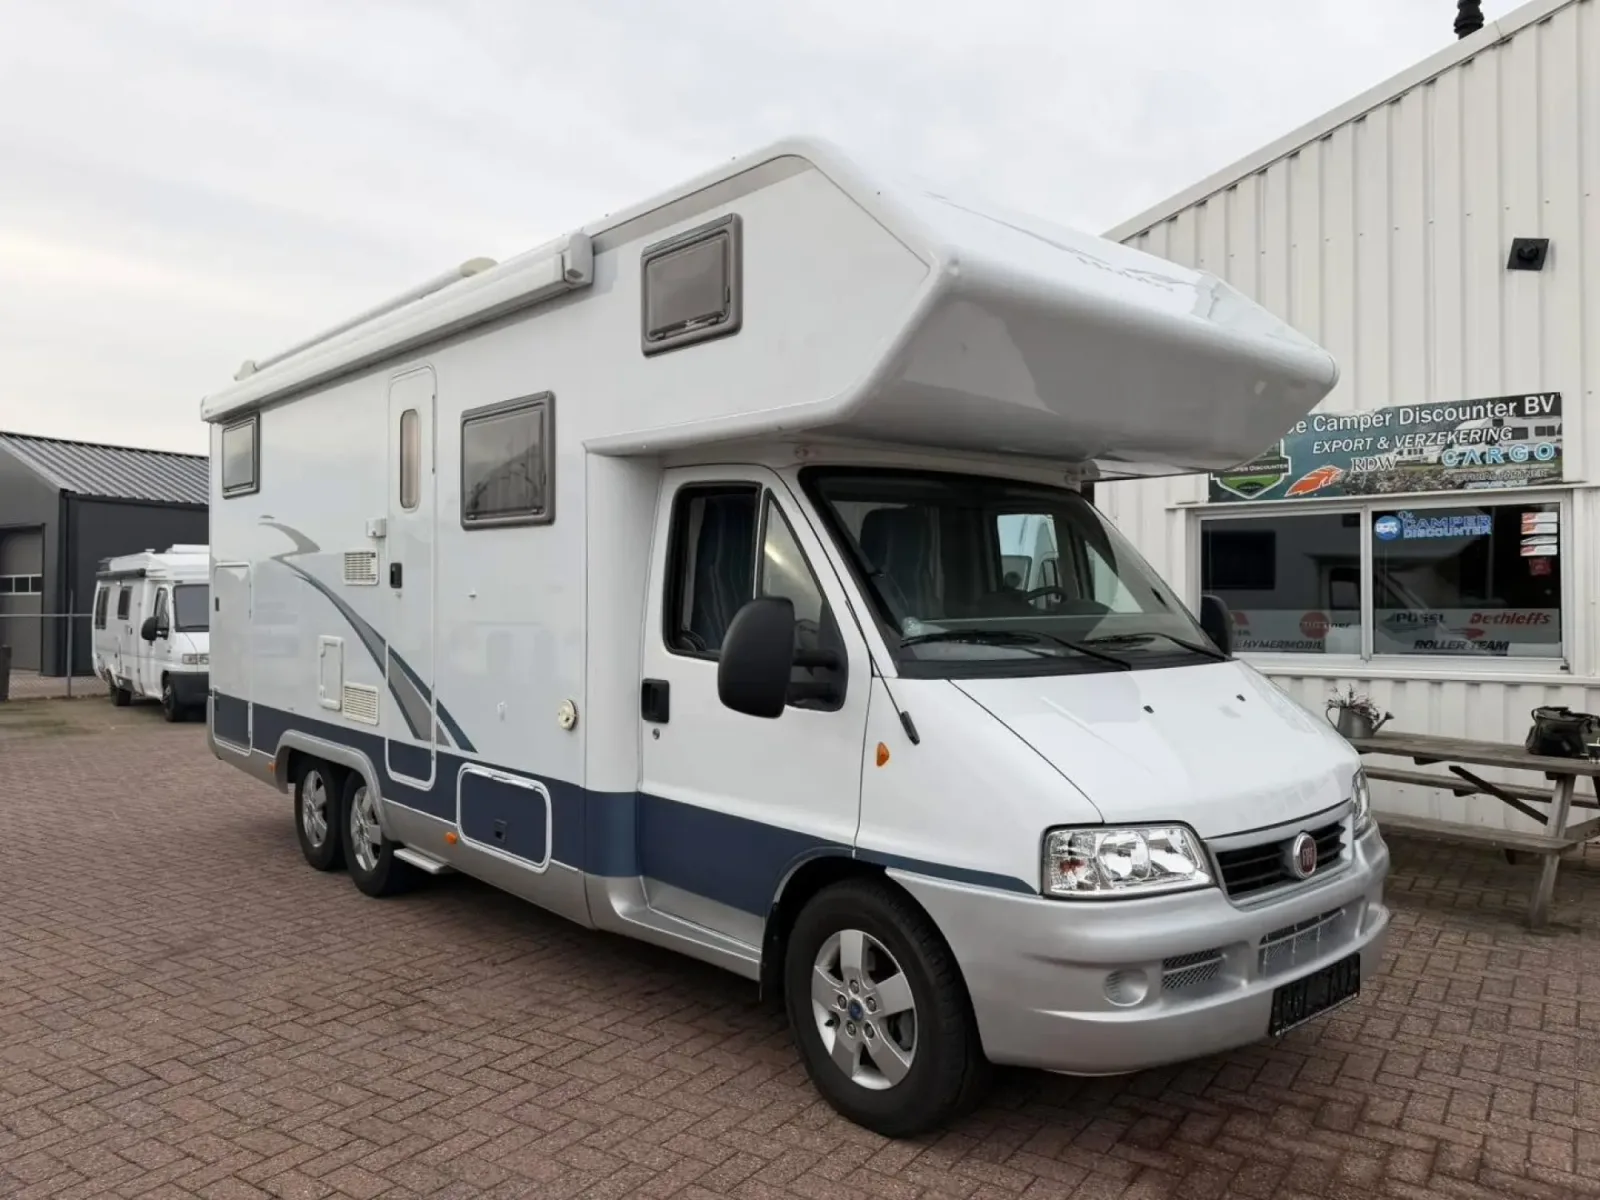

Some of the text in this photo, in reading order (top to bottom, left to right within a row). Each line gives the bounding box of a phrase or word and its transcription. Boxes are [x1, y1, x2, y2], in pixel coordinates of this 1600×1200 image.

[1287, 394, 1555, 434] e Camper Discounter BV
[1312, 426, 1513, 454] EXPORT & VERZEKERING
[1441, 441, 1556, 467] CARGO
[1350, 455, 1398, 473] RDW
[1403, 515, 1492, 529] CAMPER
[1403, 526, 1492, 538] DISCOUNTER
[1469, 612, 1551, 625] Dethleffs
[1413, 640, 1465, 650] ROLLER
